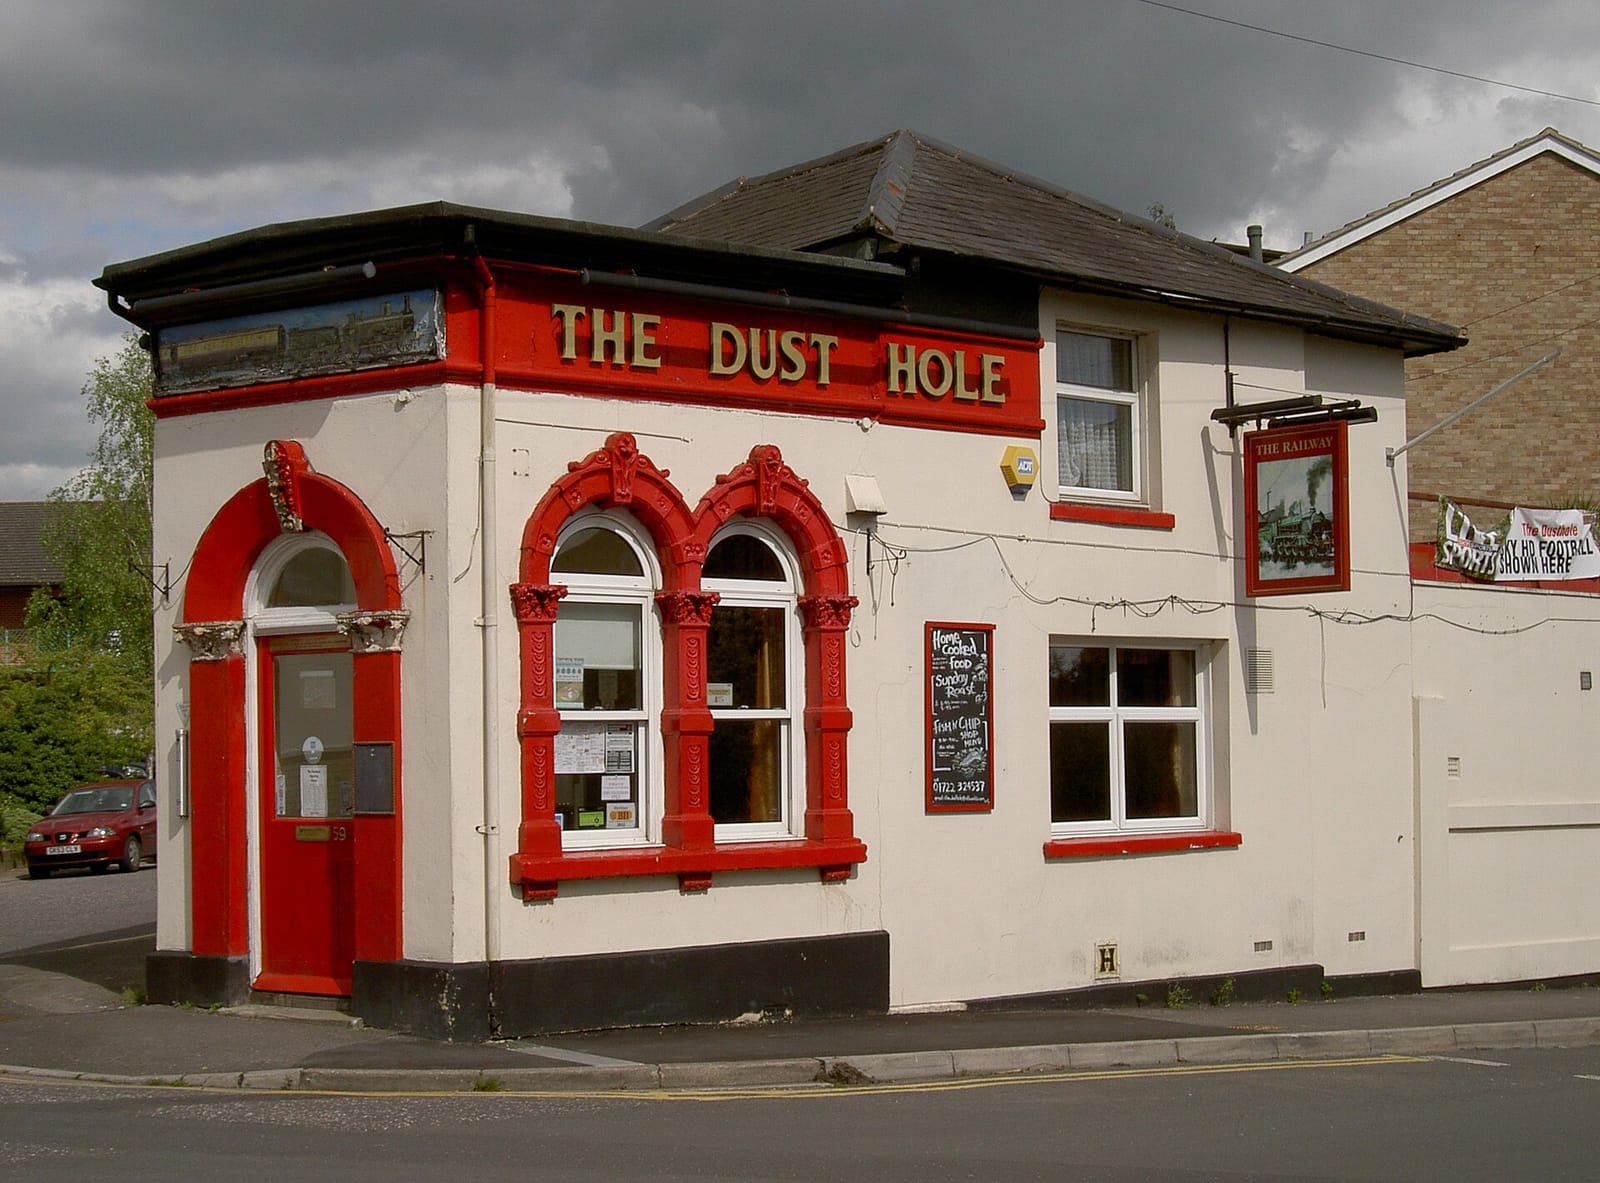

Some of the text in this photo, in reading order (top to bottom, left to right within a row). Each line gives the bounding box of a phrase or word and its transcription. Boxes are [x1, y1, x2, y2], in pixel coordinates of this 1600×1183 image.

[552, 303, 1006, 403] THE DUST HOLE
[1256, 436, 1333, 455] THE RAILWAY
[1522, 522, 1539, 536] The
[1521, 539, 1535, 557] HD
[1500, 556, 1572, 574] SHOWN HERE
[932, 630, 960, 650] Home
[935, 671, 968, 687] Sunday
[933, 781, 955, 793] 01722
[1099, 947, 1116, 972] H
